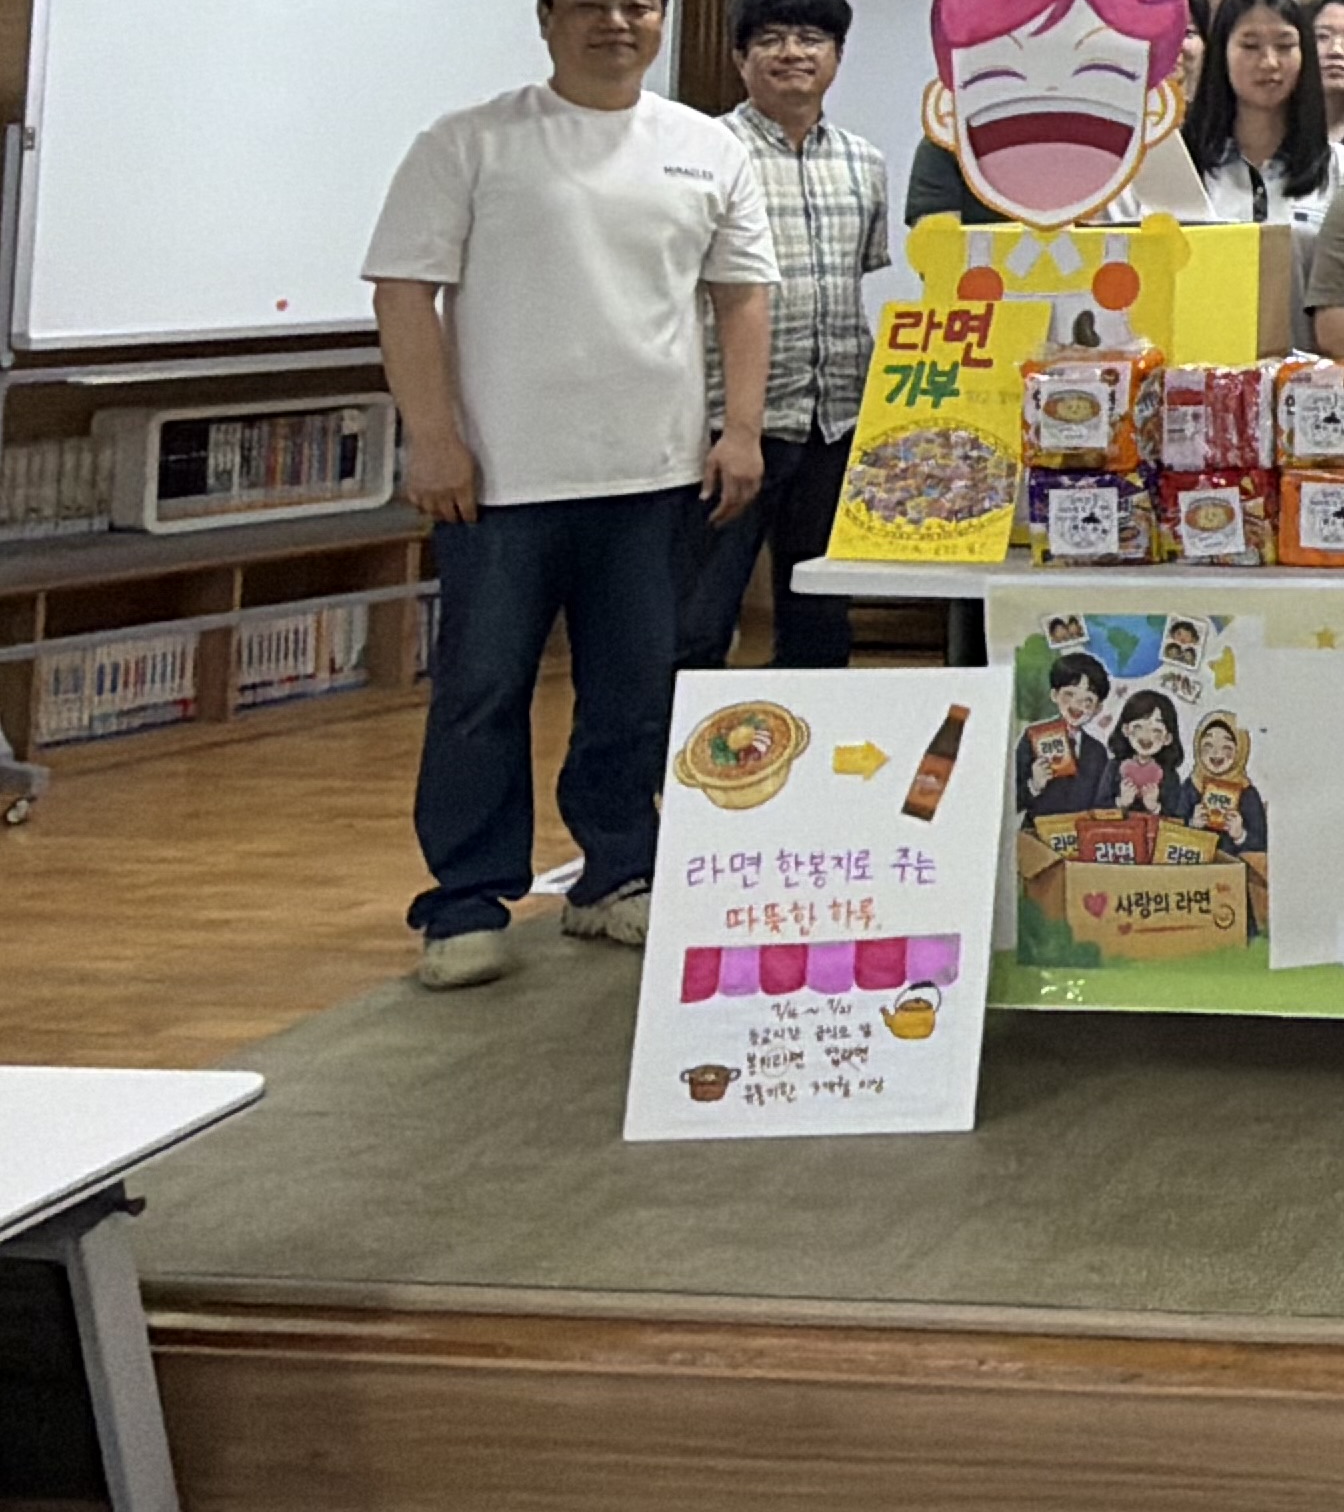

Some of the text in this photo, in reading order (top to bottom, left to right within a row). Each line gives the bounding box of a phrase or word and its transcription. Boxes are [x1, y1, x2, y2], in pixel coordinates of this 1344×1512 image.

[888, 302, 994, 368] 라면
[883, 360, 960, 409] 기부
[1041, 737, 1066, 754] 라면
[687, 846, 936, 889] 라면 한봉지로 주는
[725, 900, 817, 936] 따뜻한
[1115, 889, 1213, 918] 사랑의 라면
